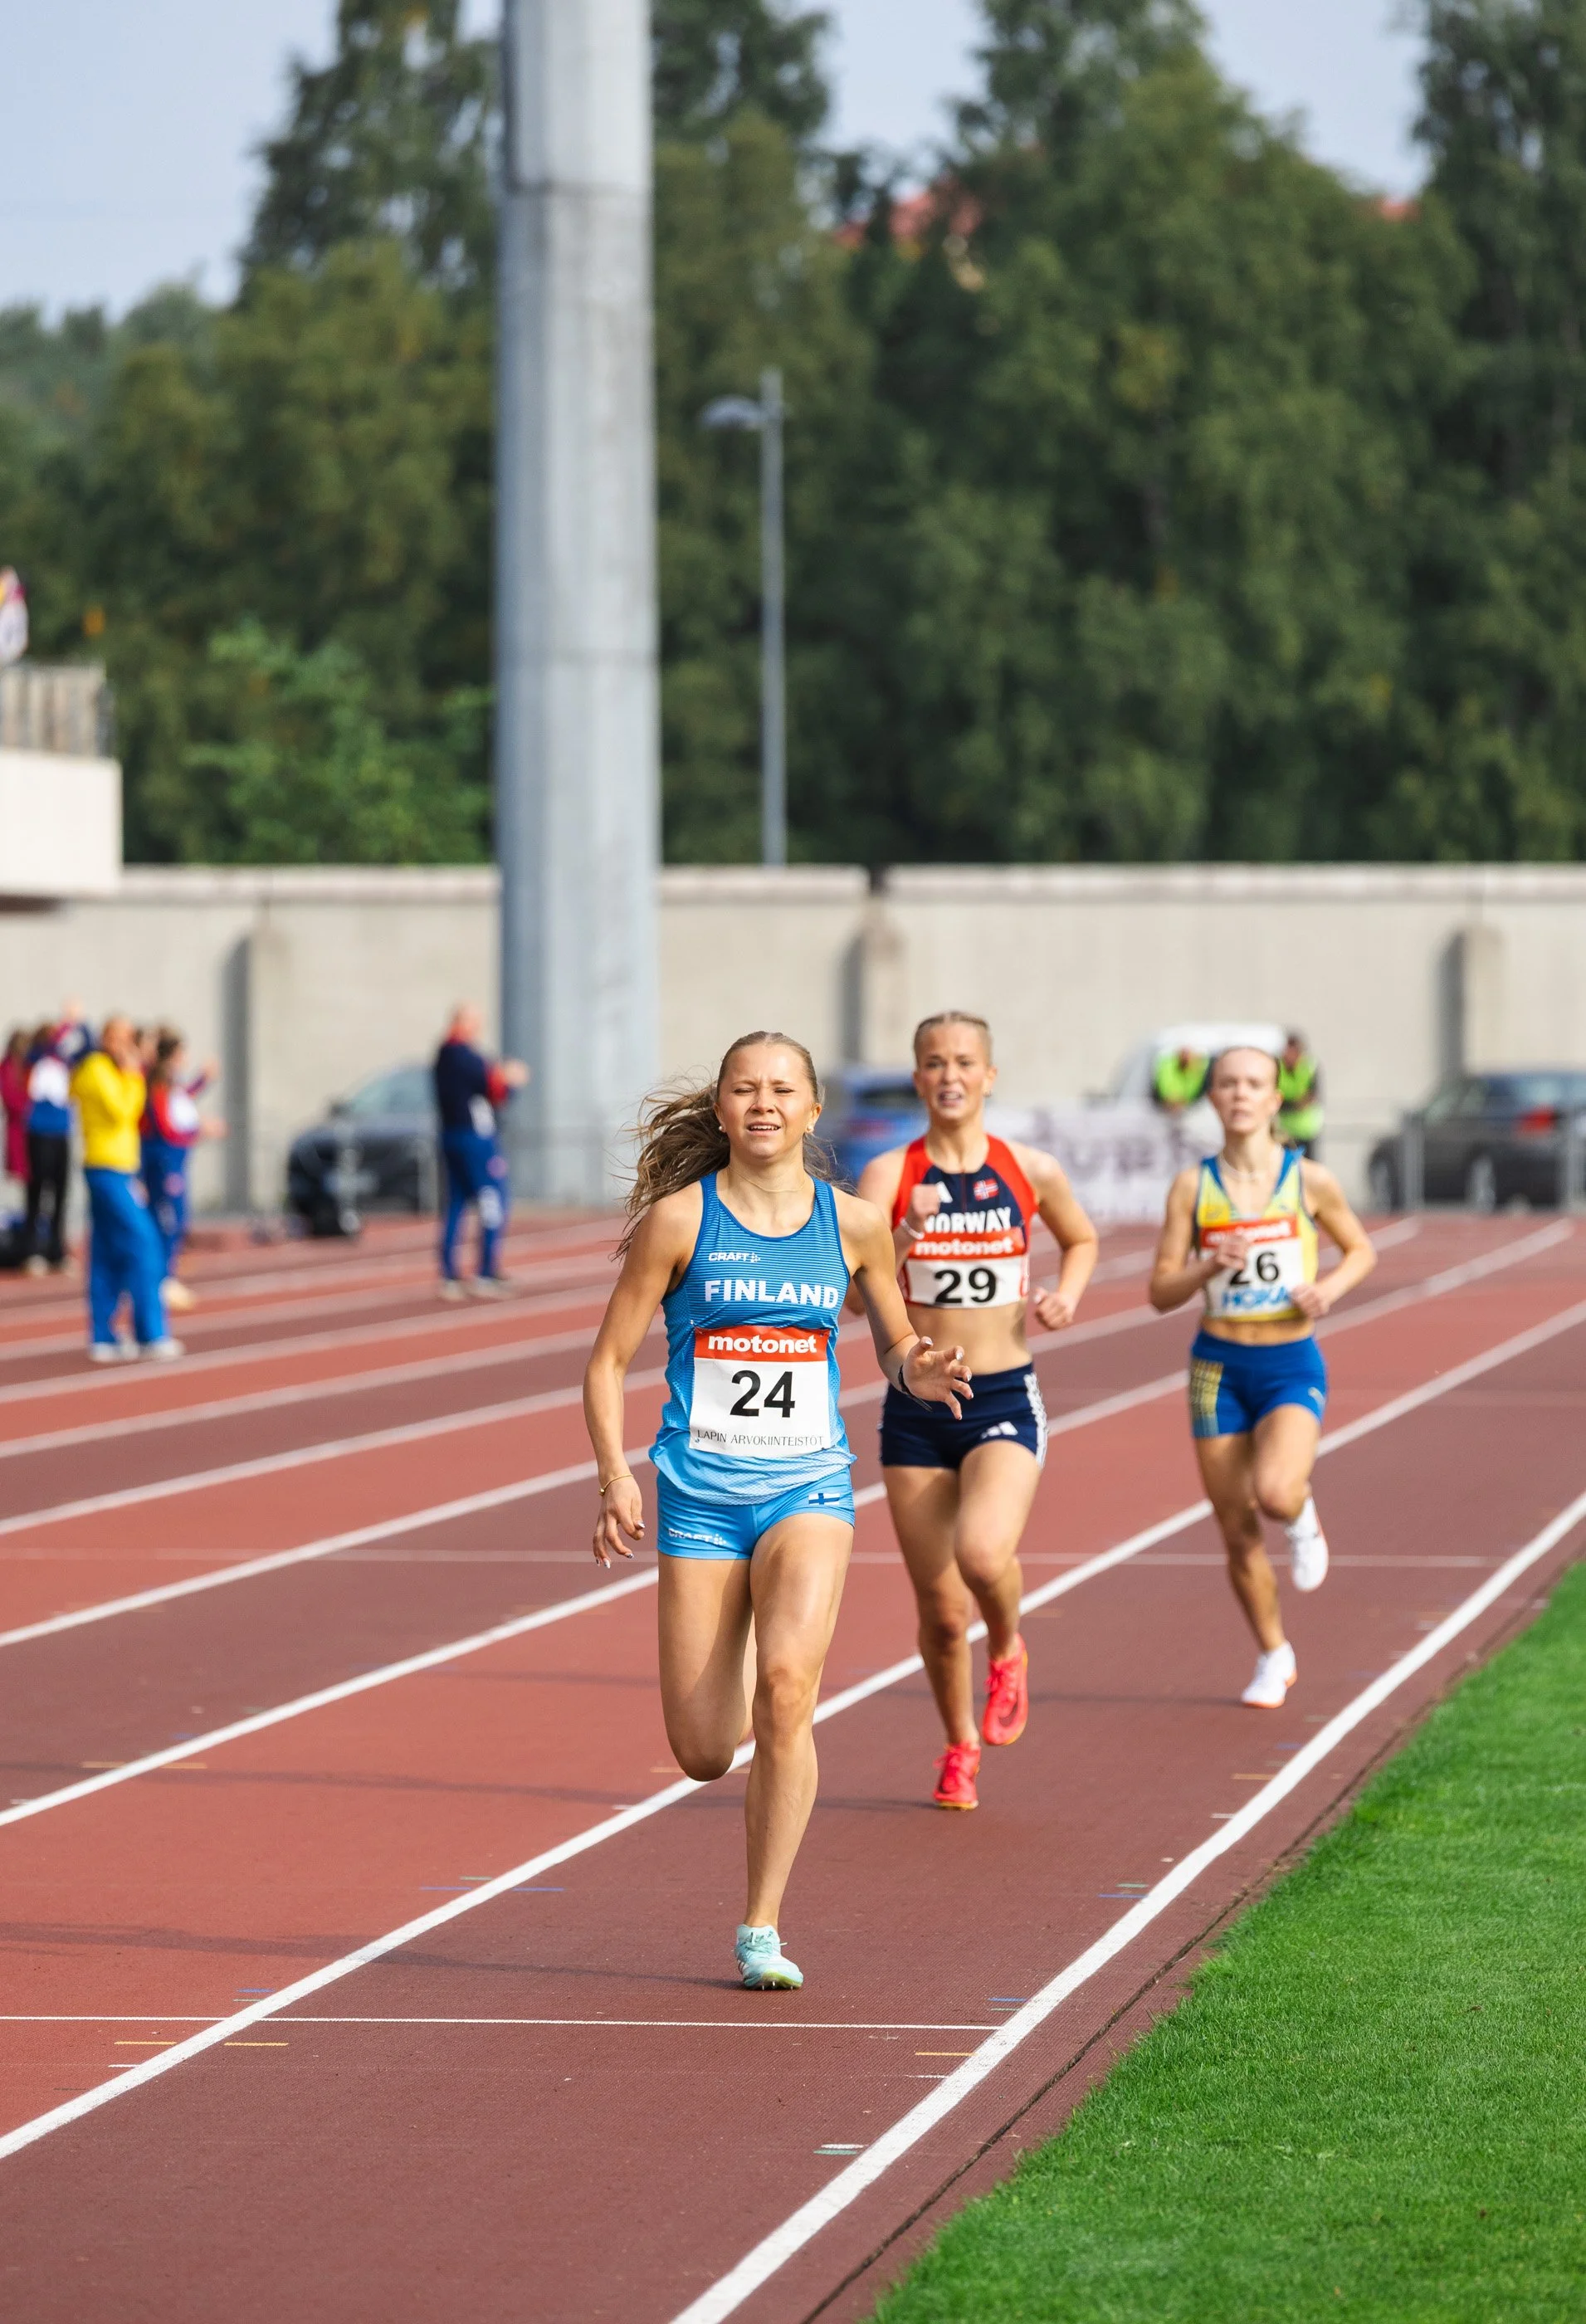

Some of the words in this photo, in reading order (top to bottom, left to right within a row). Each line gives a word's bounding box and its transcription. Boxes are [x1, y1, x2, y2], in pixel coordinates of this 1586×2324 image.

[915, 1237, 1013, 1256] motonet
[708, 1252, 749, 1262] CRAFT
[705, 1279, 839, 1309] FINLAND
[935, 1267, 997, 1304] 29
[708, 1335, 817, 1354] motonet
[730, 1370, 796, 1418] 24
[697, 1429, 727, 1443] LAPIN
